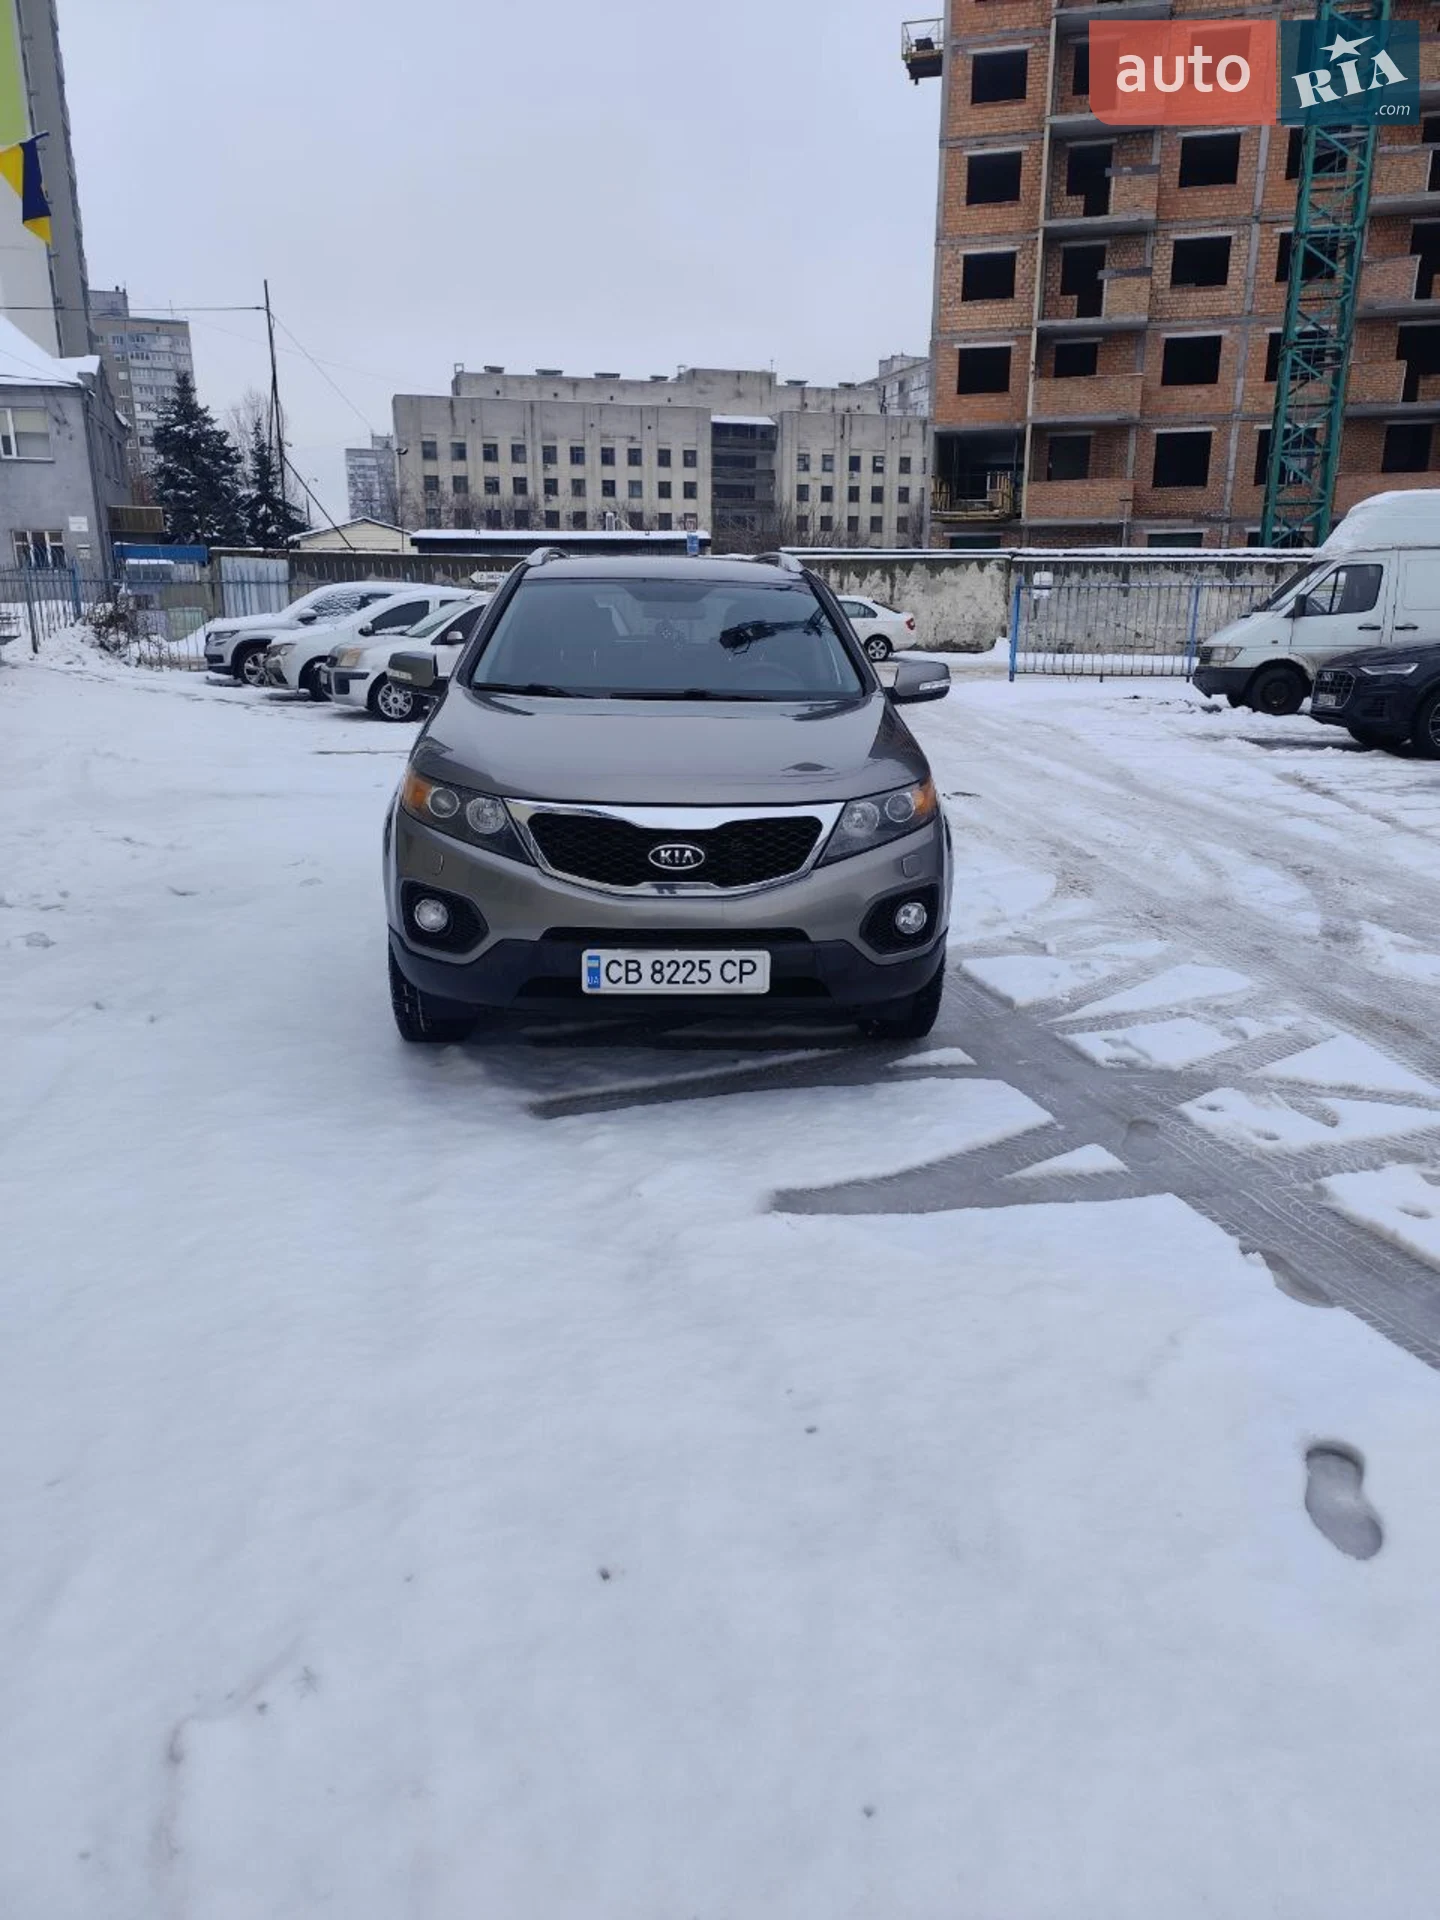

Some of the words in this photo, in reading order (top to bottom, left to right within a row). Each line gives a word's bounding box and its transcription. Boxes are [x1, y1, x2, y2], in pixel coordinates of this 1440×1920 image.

[660, 849, 695, 864] KIA
[605, 959, 643, 985] CB
[650, 959, 712, 985] 8225
[719, 959, 757, 984] CP
